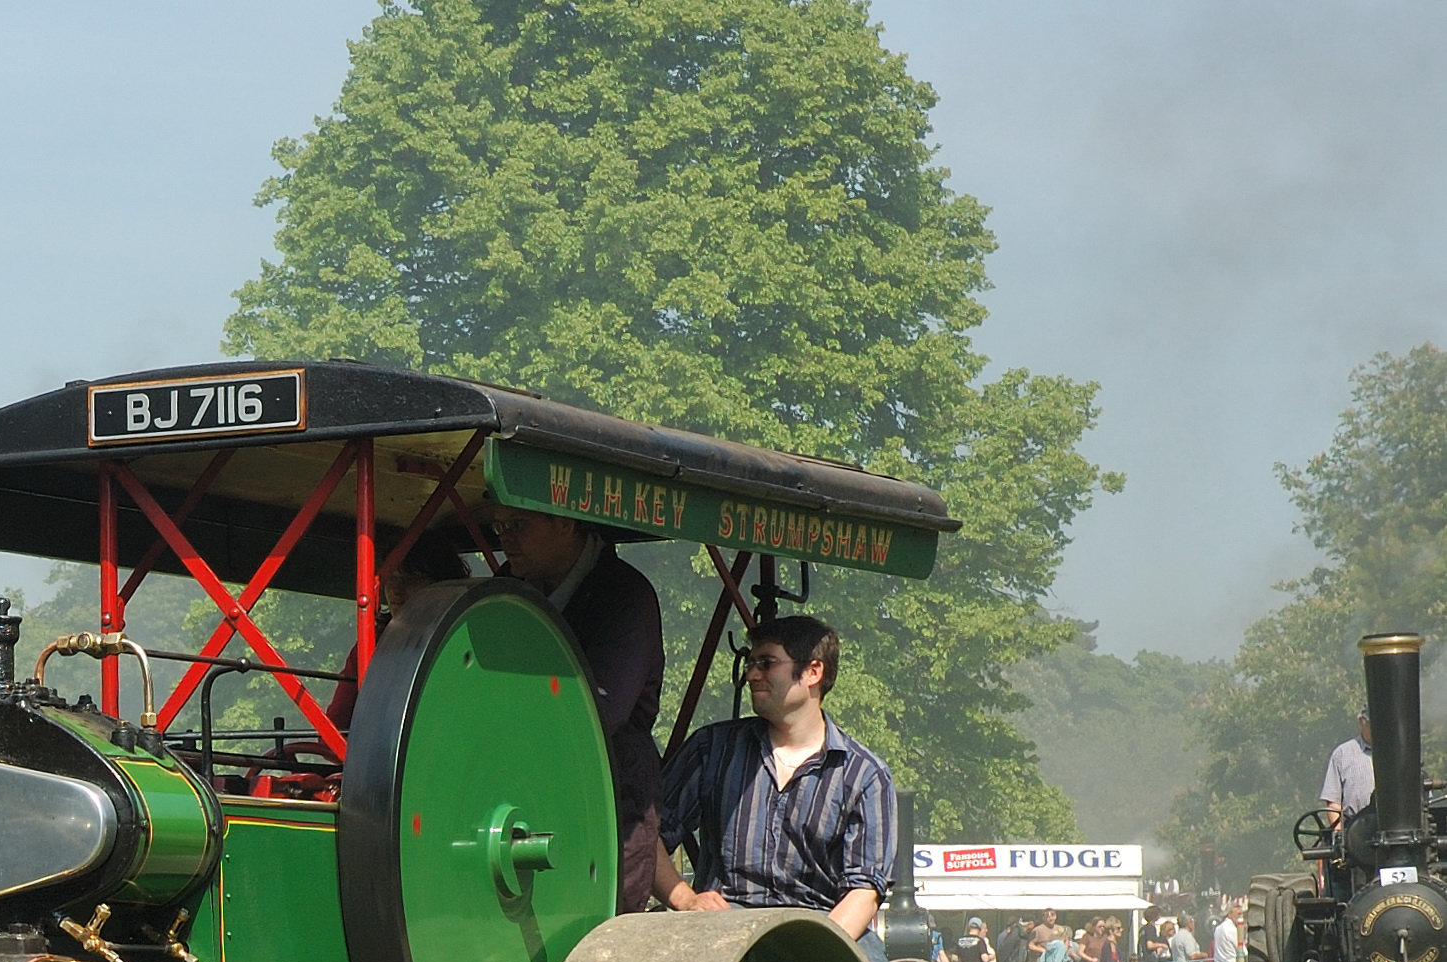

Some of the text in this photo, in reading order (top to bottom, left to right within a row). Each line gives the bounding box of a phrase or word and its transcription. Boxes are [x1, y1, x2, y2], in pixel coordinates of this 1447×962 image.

[126, 383, 263, 432] BJ 7116
[718, 500, 893, 566] STRUMPSHAW
[946, 857, 994, 870] SUFFOLK
[949, 851, 990, 861] Famous
[1009, 849, 1123, 869] FUDGE
[1391, 871, 1408, 885] 52
